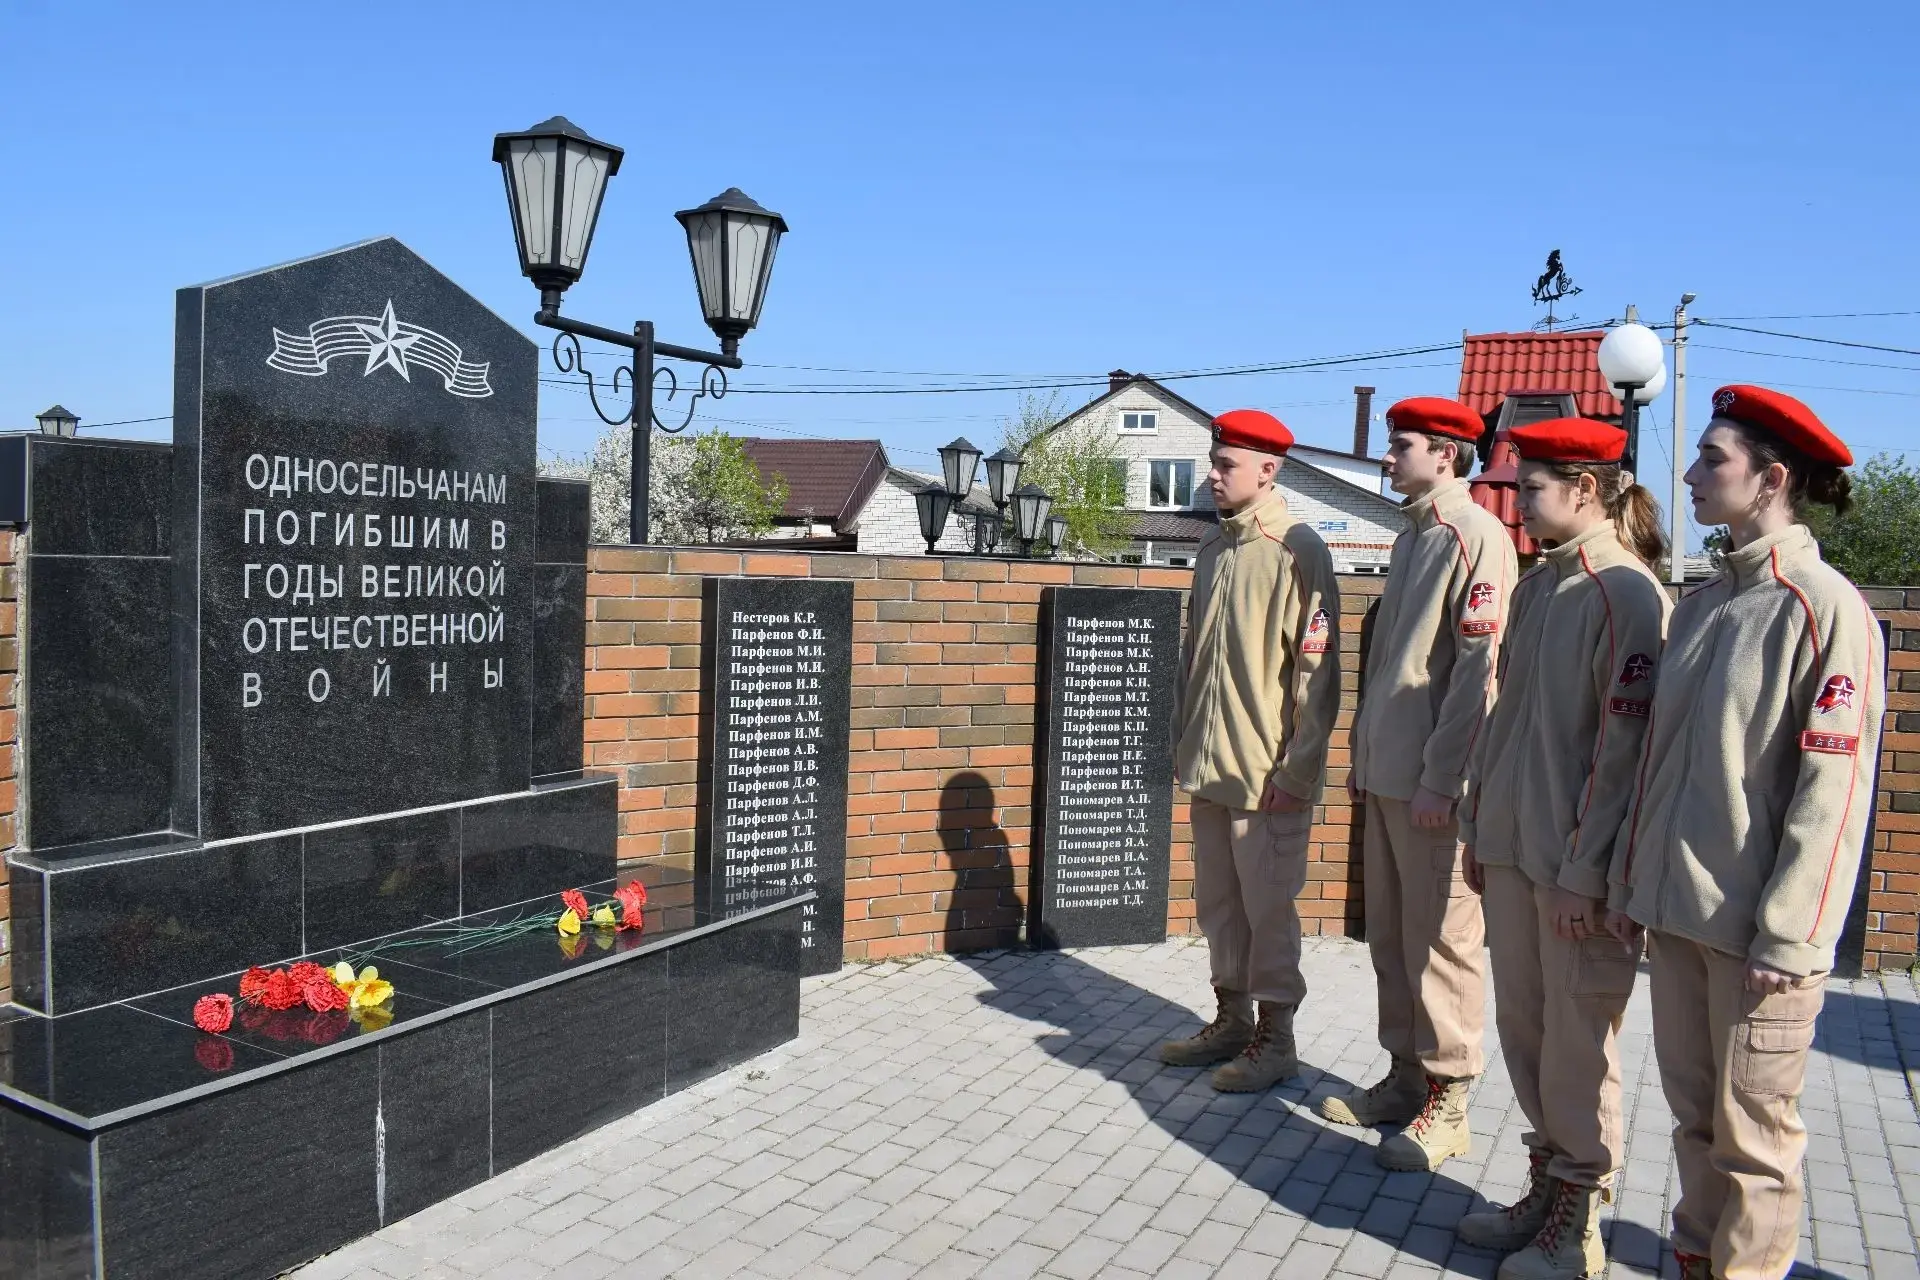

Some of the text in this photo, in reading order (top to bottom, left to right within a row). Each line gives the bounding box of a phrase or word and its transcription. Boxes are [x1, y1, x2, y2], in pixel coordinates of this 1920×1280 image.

[246, 454, 506, 504] ОДНОСЕЛЬЧАНАМ
[245, 509, 505, 549] ПОГИБШИМ В
[245, 560, 504, 605] ГОДЫ ВЕЛИКОЙ
[731, 612, 790, 626] Нестеров
[1066, 617, 1125, 630] Парфенов
[243, 606, 503, 653] ОТЕЧЕСТВЕННОЙ
[731, 629, 794, 642] Парфенов
[1066, 632, 1124, 644] Парфенов
[730, 646, 794, 659] Парфенов
[1065, 647, 1124, 659] Парфенов
[730, 663, 793, 676] Парфенов
[1065, 662, 1123, 674] Парфенов
[730, 680, 793, 693] Парфенов
[1064, 677, 1122, 689] Парфенов
[729, 697, 792, 710] Парфенов
[1063, 692, 1122, 704] Парфенов
[1063, 707, 1121, 719] Парфенов
[729, 713, 792, 727] Парфенов
[1062, 722, 1121, 734] Парфенов
[728, 730, 791, 744] Парфенов
[1062, 737, 1120, 748] Парфенов
[728, 747, 791, 760] Парфенов
[1061, 751, 1119, 763] Парфенов
[727, 763, 790, 777] Парфенов
[1061, 766, 1119, 777] Парфенов
[727, 780, 790, 794] Парфенов
[1060, 781, 1118, 792] Парфенов
[726, 797, 789, 810] Парфенов
[1059, 796, 1123, 807] Пономарев
[725, 813, 789, 827] Парфенов
[1059, 811, 1123, 821] Пономарев
[725, 830, 788, 844] Парфенов
[1058, 825, 1122, 836] Пономарев
[1057, 840, 1122, 851] Пономарев
[725, 846, 788, 861] Парфенов
[1057, 855, 1121, 865] Пономарев
[724, 862, 787, 877] Парфенов
[1056, 869, 1120, 879] Пономарев
[1056, 884, 1120, 894] Пономарев
[1055, 899, 1119, 908] Пономарев
